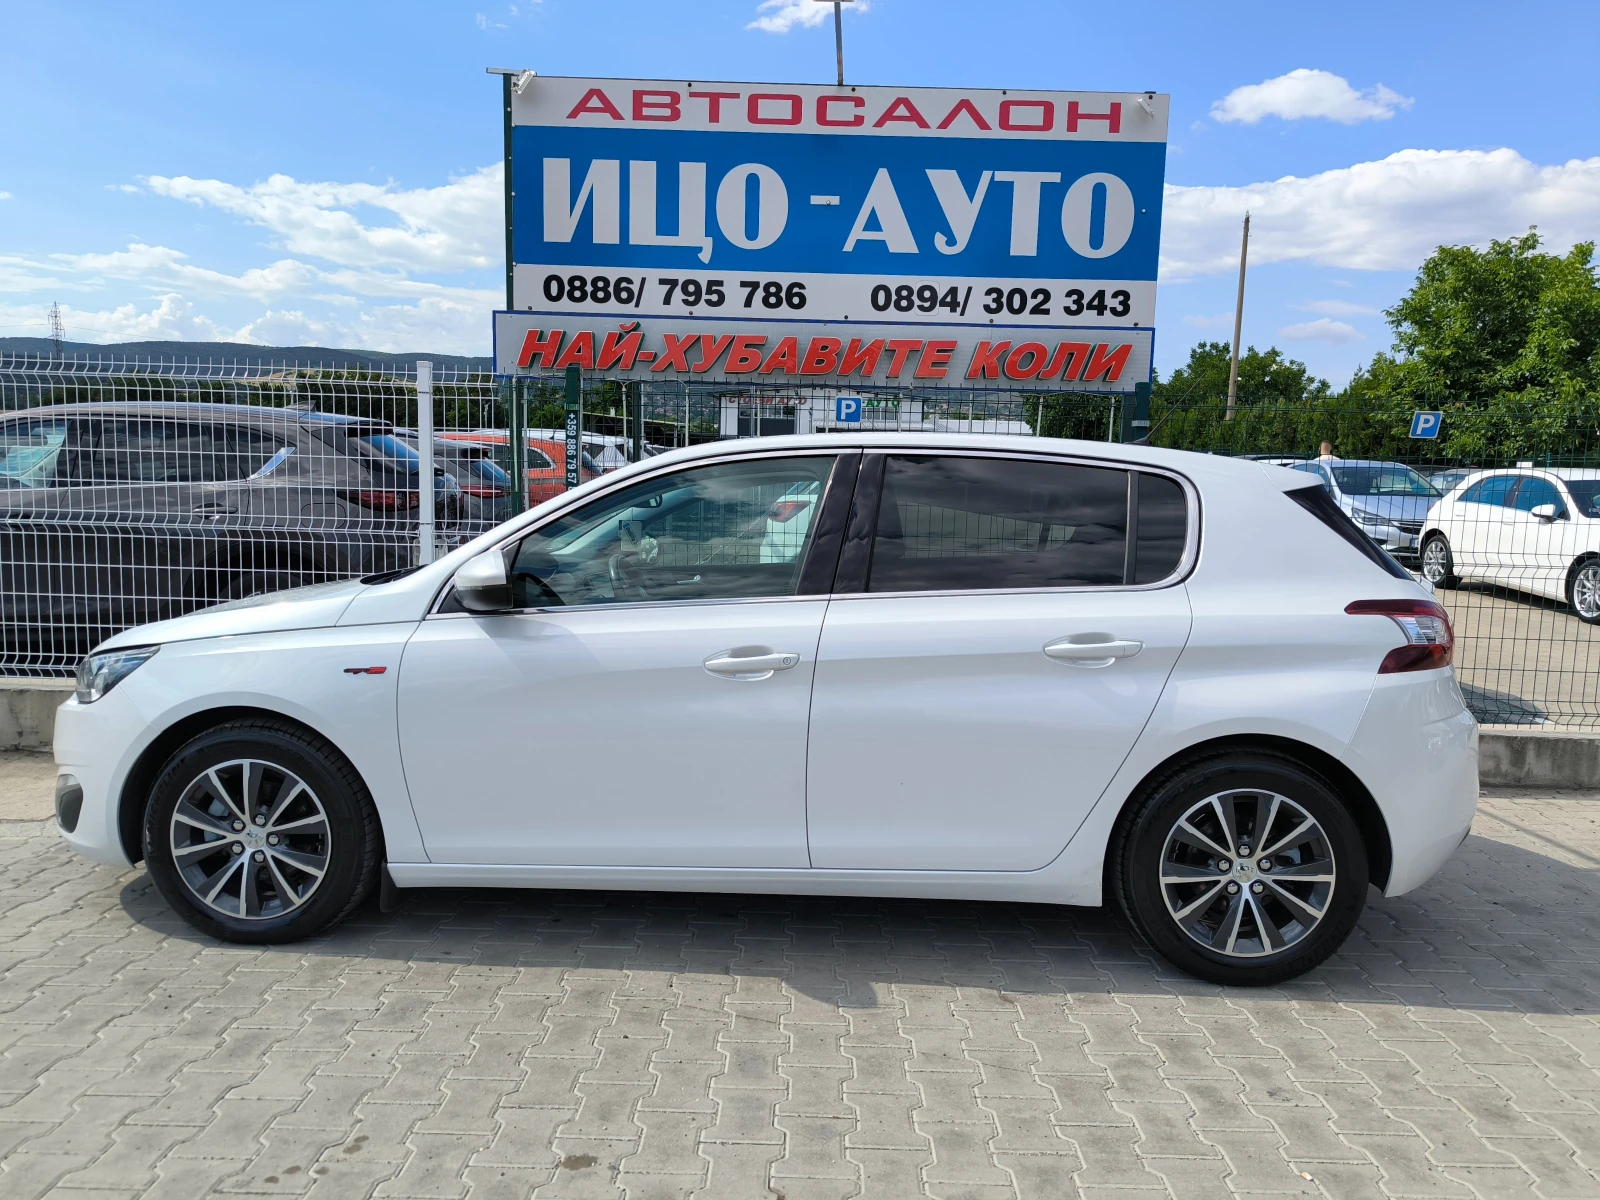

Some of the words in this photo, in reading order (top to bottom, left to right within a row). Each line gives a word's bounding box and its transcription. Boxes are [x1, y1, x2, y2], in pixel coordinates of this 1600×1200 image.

[565, 88, 1122, 134] АВТОСАЛОН
[542, 157, 789, 265] ИЦО
[543, 274, 647, 308] 0886/
[658, 278, 726, 308] 795
[739, 281, 808, 310] 786
[870, 283, 973, 316] 0894/
[982, 286, 1051, 316] 302
[1063, 289, 1132, 318] 343
[516, 320, 958, 380] НАЙ-ХУБАВИТЕ
[964, 339, 1134, 382] КОЛИ
[840, 400, 857, 420] P
[566, 412, 577, 436] +359
[1415, 414, 1436, 435] P
[566, 438, 577, 456] 886
[566, 458, 577, 470] 79
[567, 472, 577, 484] 57
